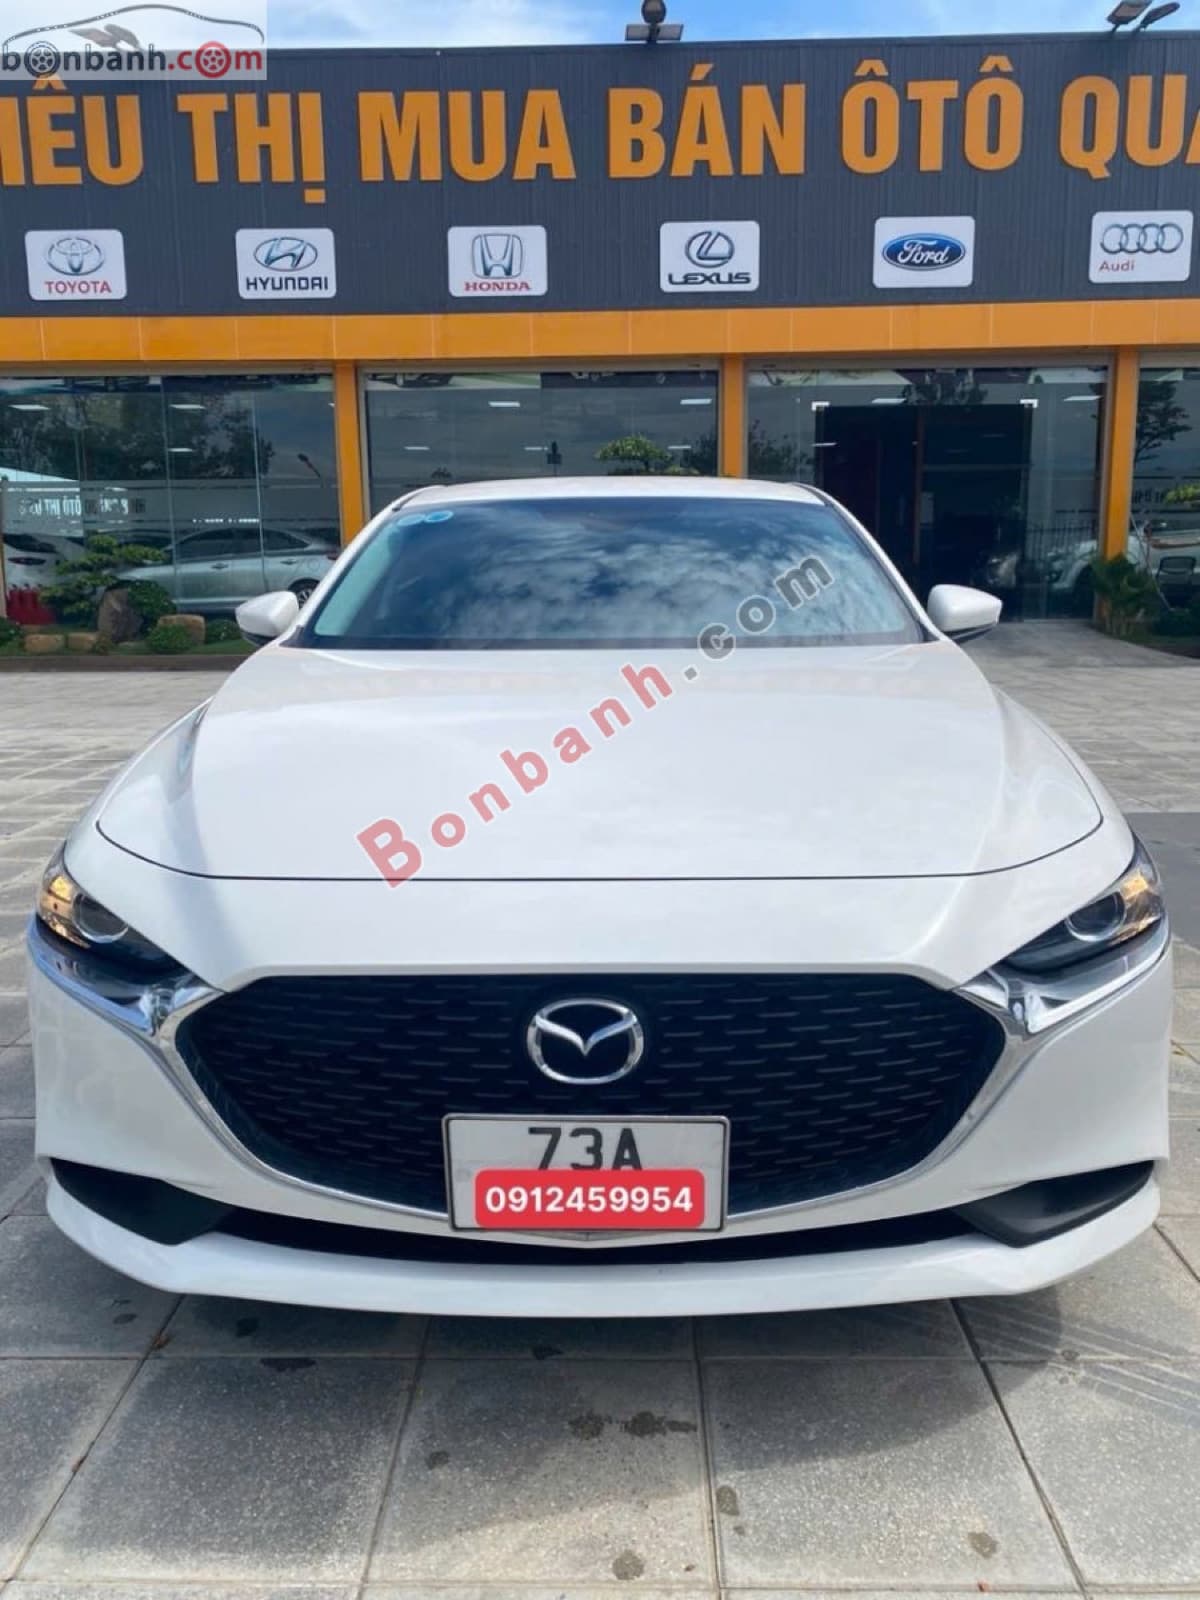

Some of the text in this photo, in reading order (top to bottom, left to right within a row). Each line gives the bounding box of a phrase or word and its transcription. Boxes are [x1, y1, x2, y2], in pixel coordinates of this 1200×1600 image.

[177, 92, 325, 203] THỊ
[358, 90, 576, 181] MUA
[608, 64, 806, 178] BÁN
[841, 55, 1024, 174] ÔTÔ
[1060, 74, 1200, 179] QU
[897, 239, 951, 264] Ford
[1099, 259, 1135, 273] Audi
[245, 276, 329, 292] HYUNDAI
[464, 281, 531, 292] HONDA
[668, 272, 751, 286] LEXUS
[44, 280, 112, 294] TOYOTA
[528, 1127, 643, 1171] 73A
